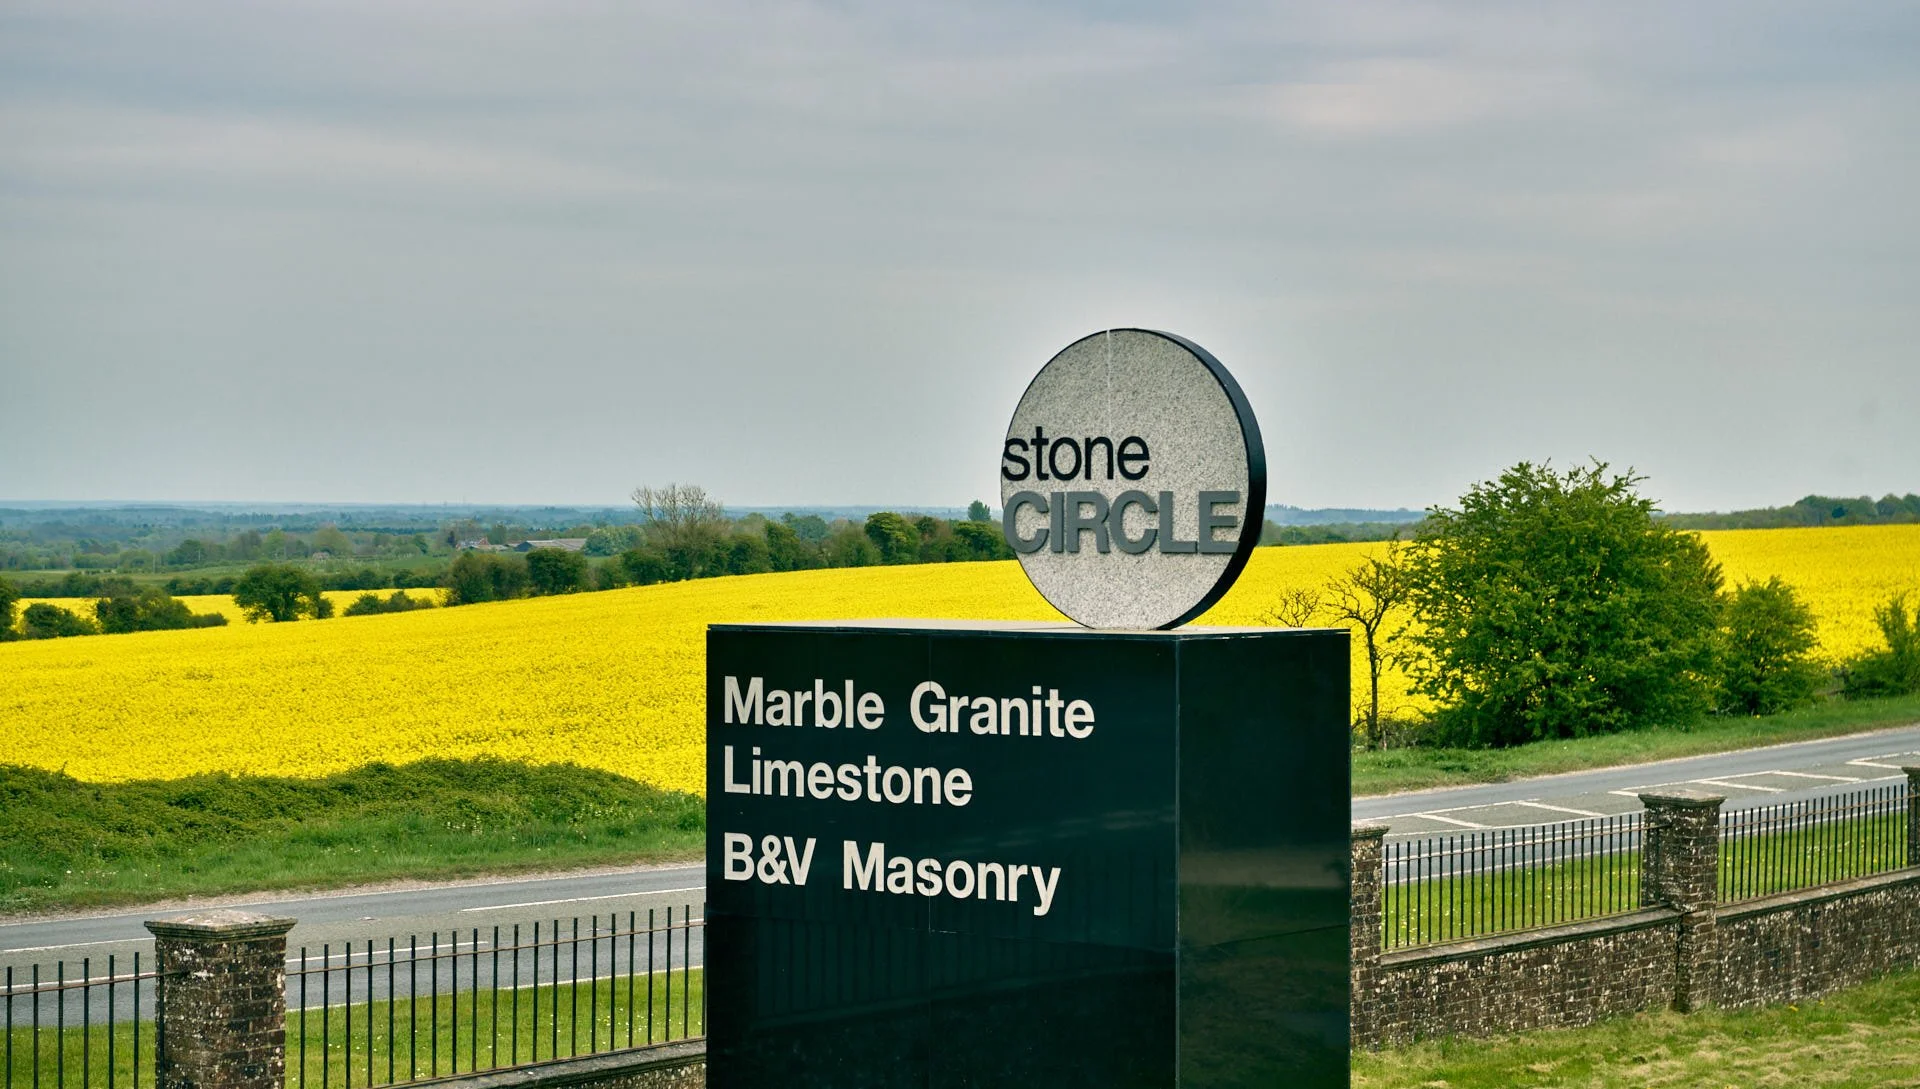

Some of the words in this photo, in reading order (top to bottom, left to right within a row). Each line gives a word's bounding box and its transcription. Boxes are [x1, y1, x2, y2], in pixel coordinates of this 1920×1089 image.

[1002, 426, 1150, 481] stone
[1003, 490, 1240, 554] CIRCLE
[725, 676, 884, 729] Marble
[910, 681, 1095, 738] Granite
[725, 746, 972, 806] Limestone
[725, 832, 816, 885] B&V
[844, 840, 1061, 916] Masonry
